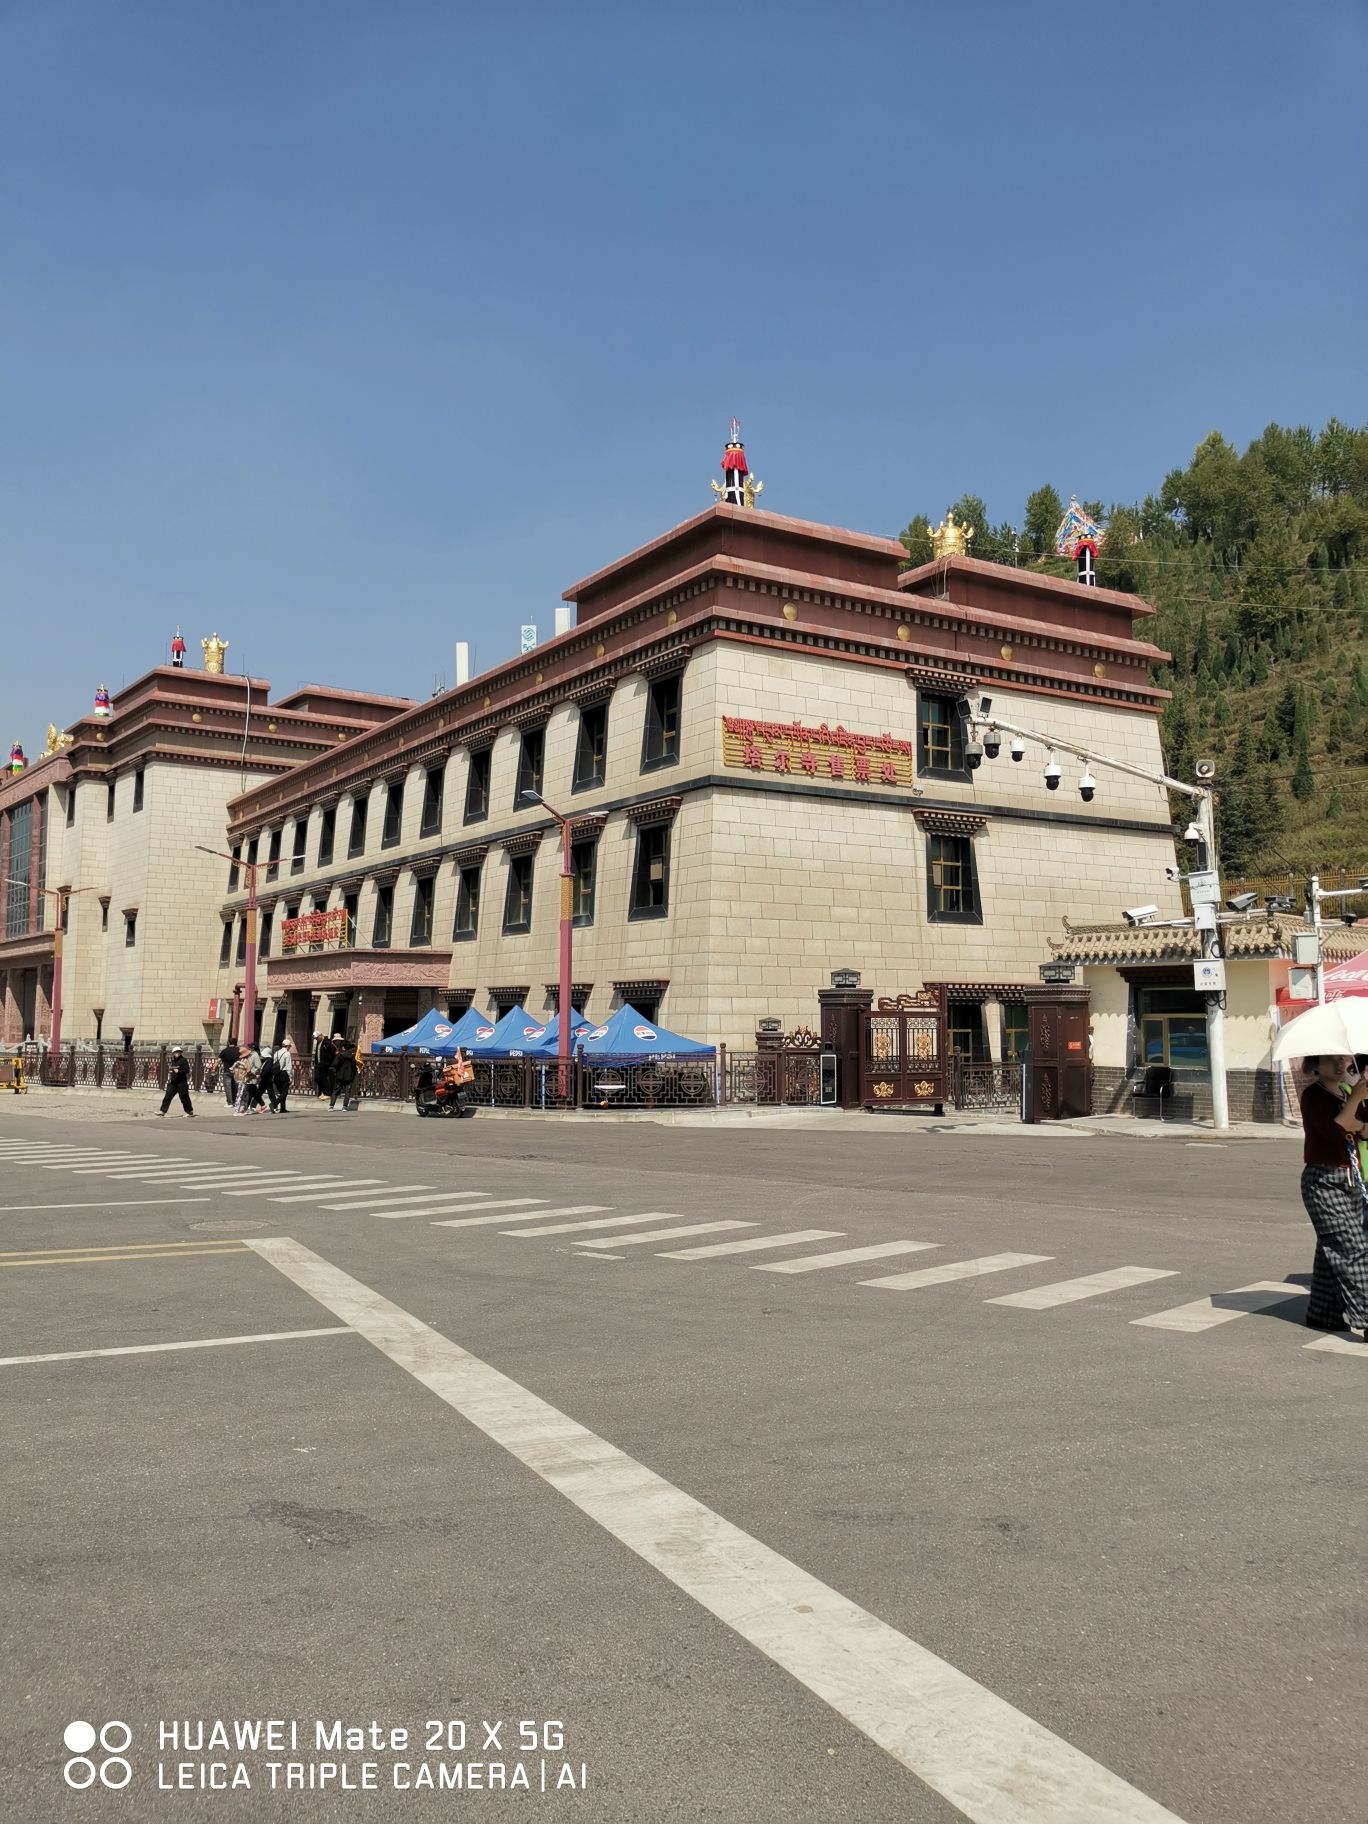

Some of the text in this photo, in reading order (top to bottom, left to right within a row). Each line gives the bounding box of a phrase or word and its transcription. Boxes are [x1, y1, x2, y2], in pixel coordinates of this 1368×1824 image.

[742, 744, 898, 783] 塔尔寺售票处
